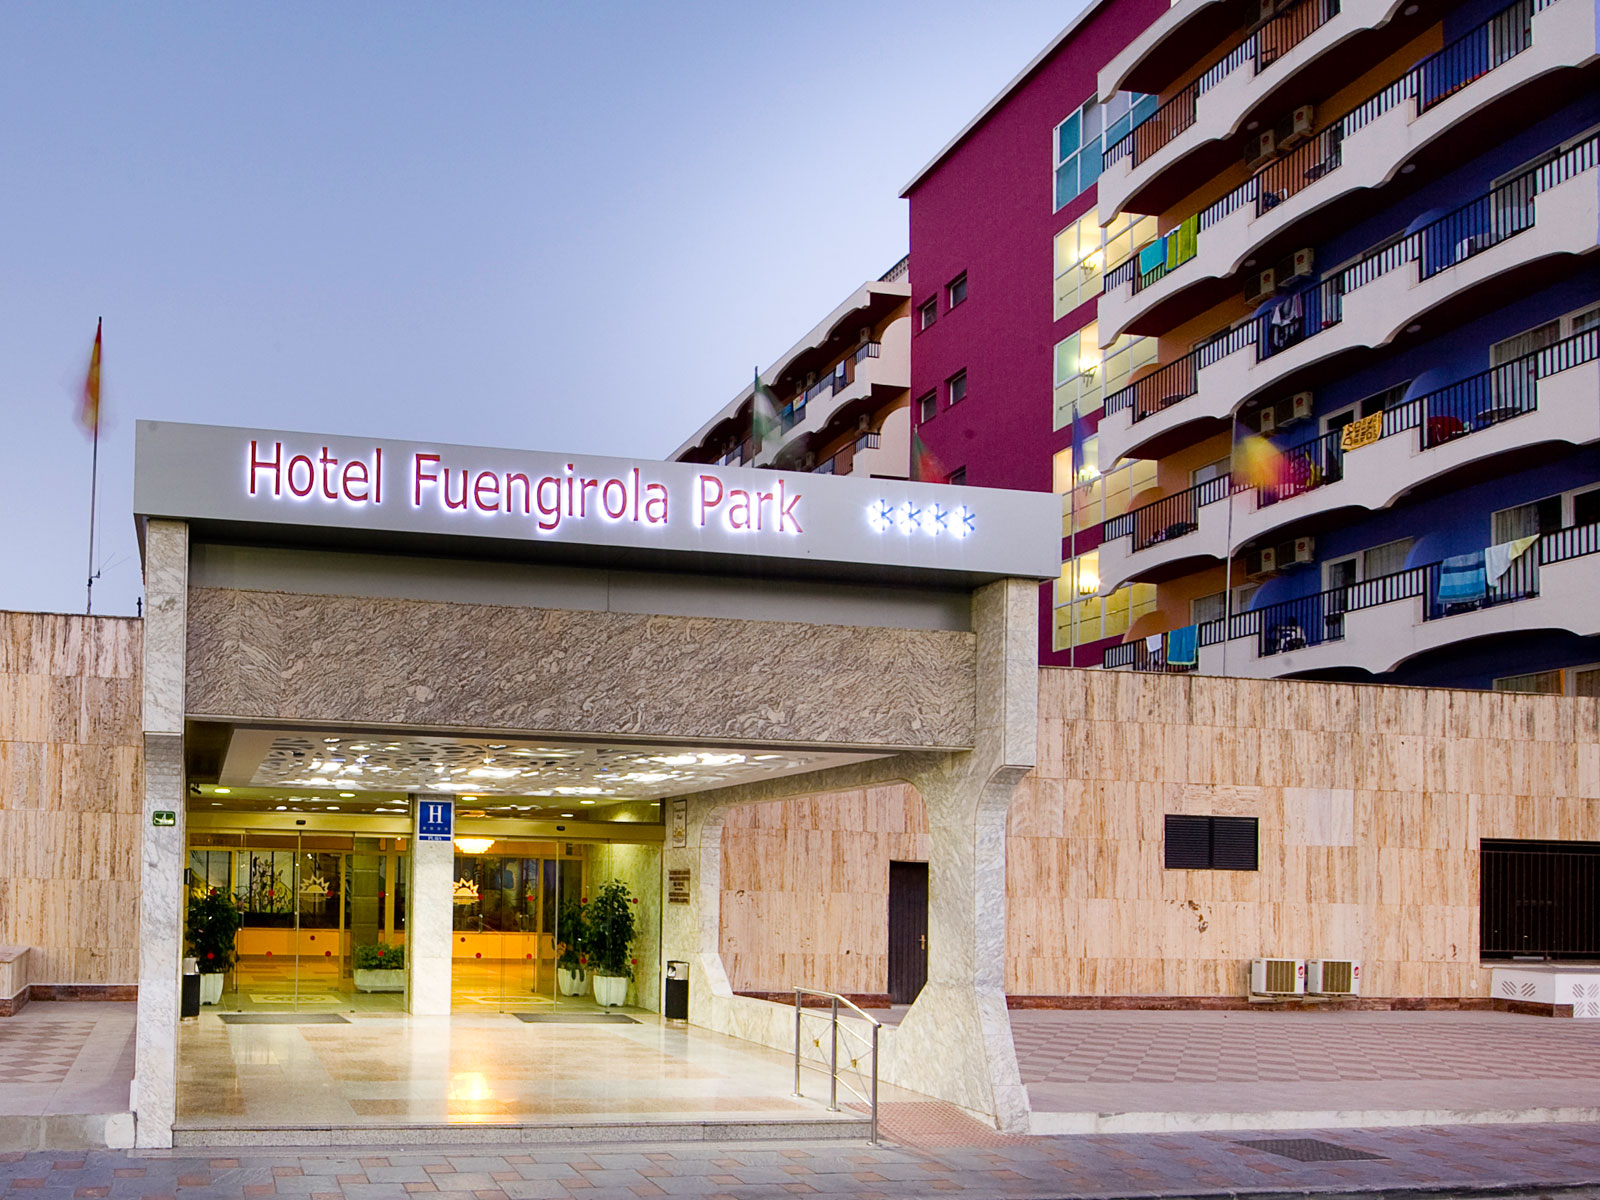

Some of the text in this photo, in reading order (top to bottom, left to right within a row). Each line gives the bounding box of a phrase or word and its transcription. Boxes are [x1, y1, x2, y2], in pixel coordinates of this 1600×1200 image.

[249, 440, 803, 533] Hotel Fuengirola Park
[427, 804, 444, 824] H
